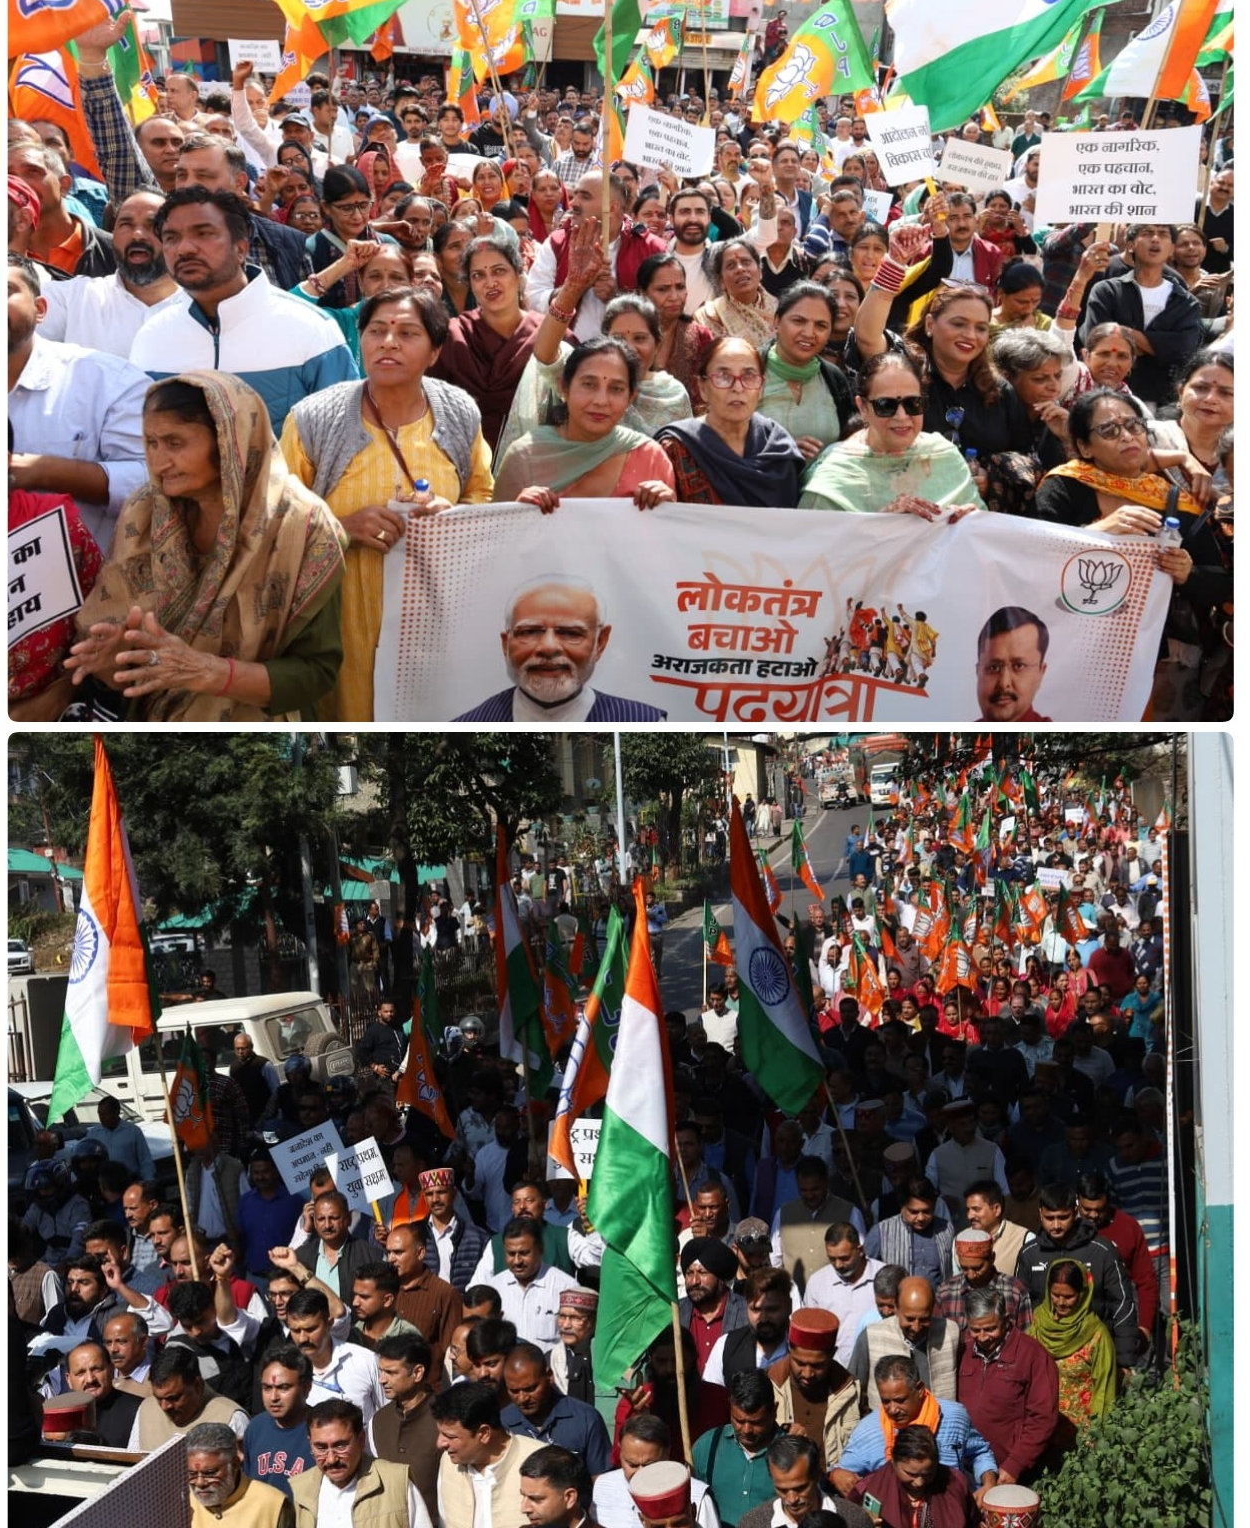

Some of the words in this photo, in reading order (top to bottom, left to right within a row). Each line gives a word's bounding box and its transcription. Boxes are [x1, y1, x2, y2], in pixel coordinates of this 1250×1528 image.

[692, 33, 710, 44] STOE
[880, 127, 917, 145] आंदोलन
[1076, 142, 1099, 154] एक
[885, 148, 923, 168] विकास
[1078, 163, 1101, 175] एक
[1072, 184, 1104, 195] भारत
[1107, 184, 1127, 195] का
[1069, 204, 1101, 215] भारत
[1104, 201, 1124, 215] की
[1126, 204, 1158, 217] शान
[11, 536, 42, 565] का
[676, 572, 823, 618] लोकतंत्र
[687, 619, 799, 654] बचाओ
[651, 653, 752, 676] अराजकता
[756, 656, 819, 678] हटाओ
[649, 673, 930, 722] पदयात्रा
[313, 1132, 325, 1141] का
[338, 1155, 359, 1171] राष्ट्र
[346, 1179, 364, 1198] युवा
